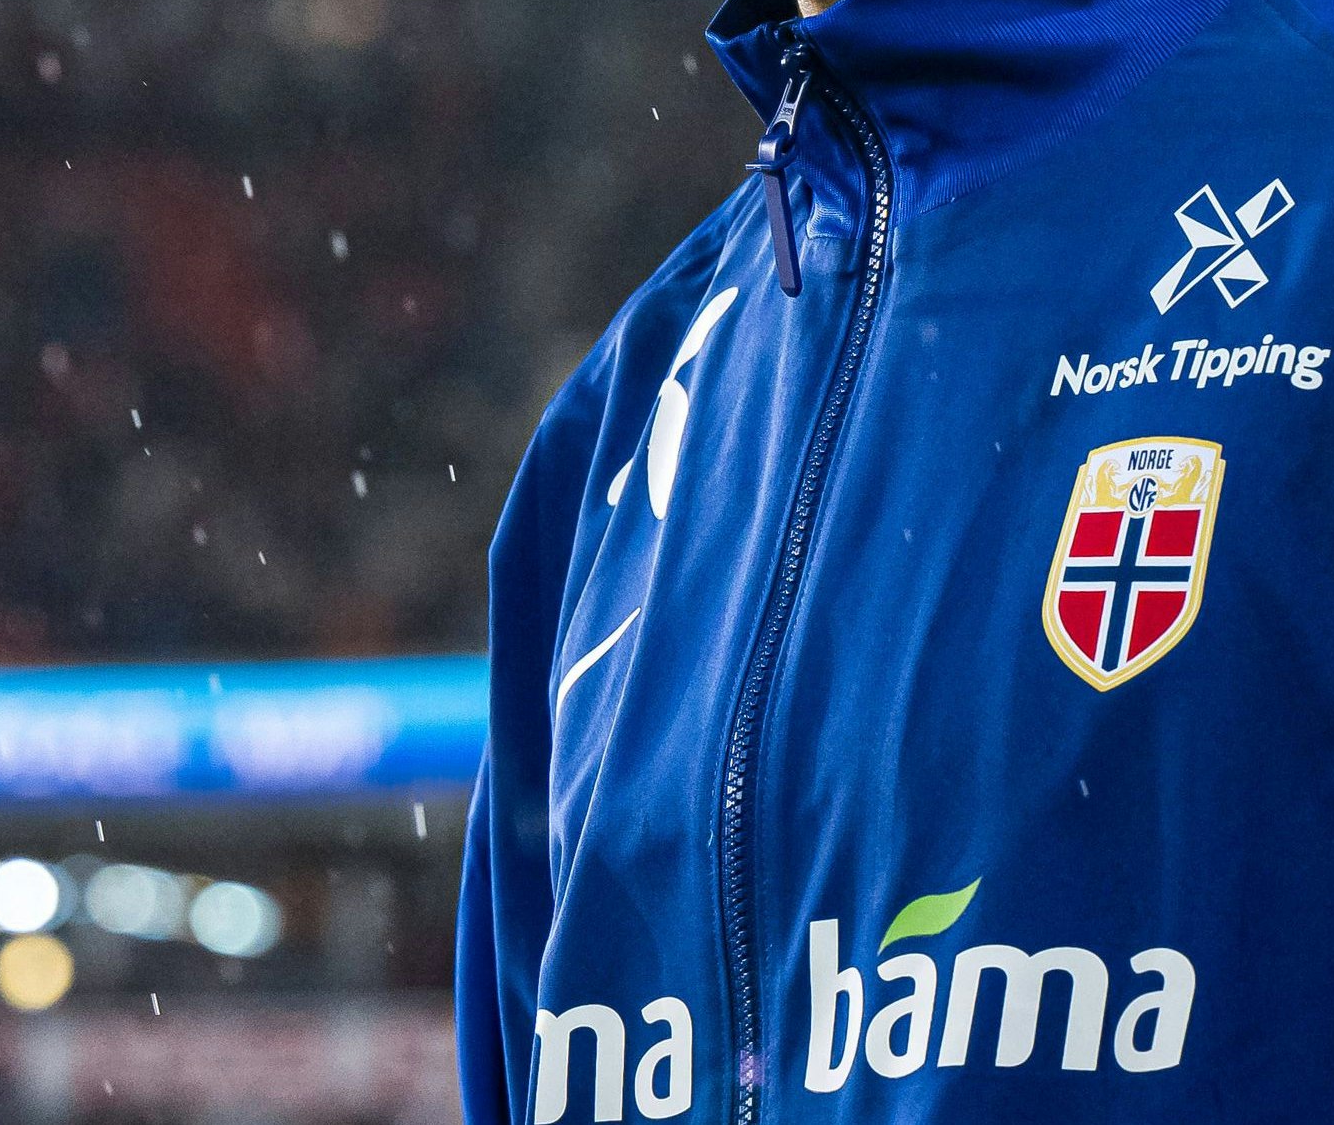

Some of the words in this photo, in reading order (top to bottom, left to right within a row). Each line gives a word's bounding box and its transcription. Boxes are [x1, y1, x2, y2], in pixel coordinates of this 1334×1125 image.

[1049, 343, 1166, 397] Norsk
[1169, 333, 1332, 390] Tipping
[1127, 449, 1175, 471] NORGE
[804, 918, 1197, 1094] bama
